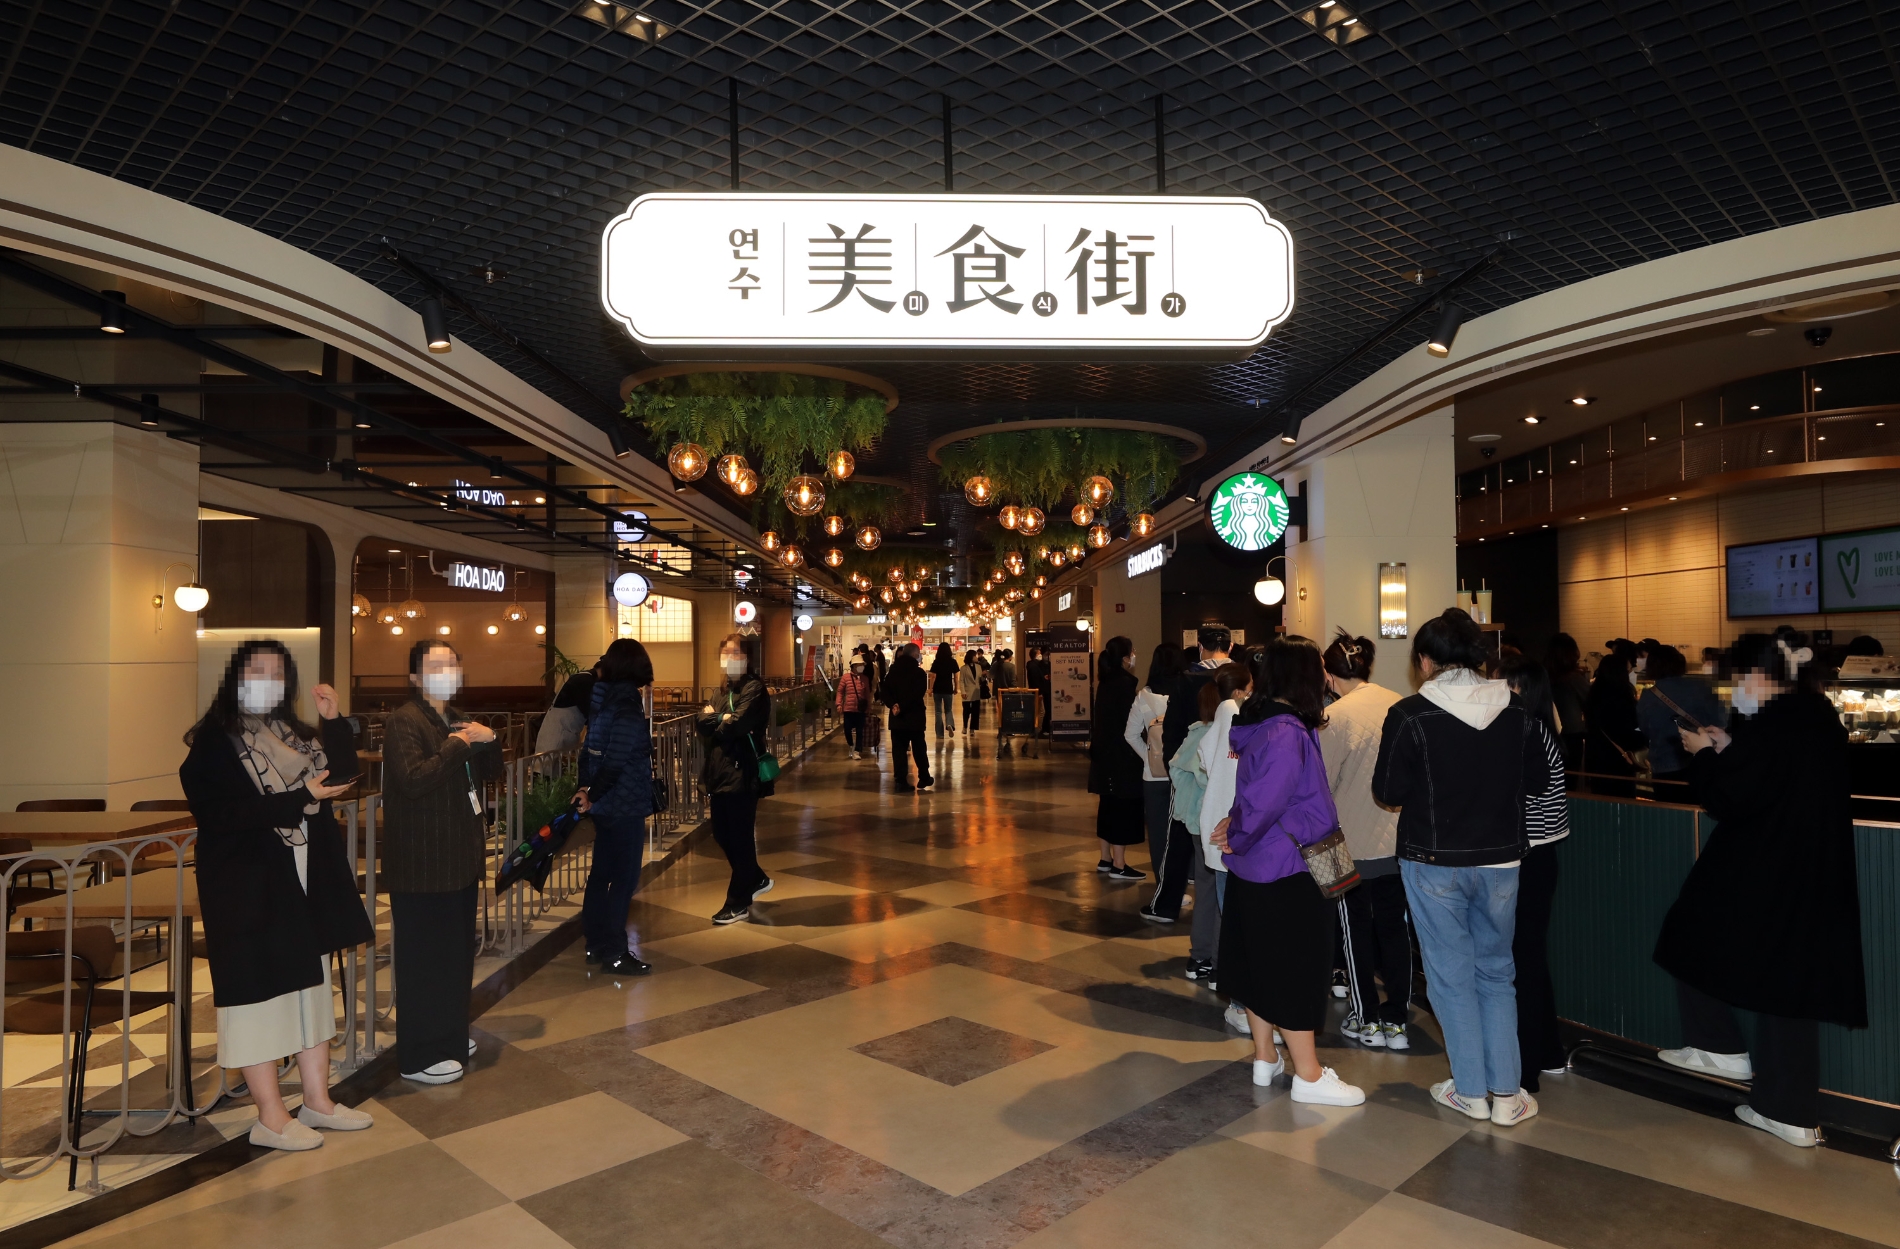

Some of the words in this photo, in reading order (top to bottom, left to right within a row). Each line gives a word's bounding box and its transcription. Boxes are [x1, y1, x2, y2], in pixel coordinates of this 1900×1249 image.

[727, 228, 762, 300] 연수
[908, 294, 925, 312] 미
[1036, 295, 1053, 314] 식
[1165, 295, 1183, 314] 가
[1127, 543, 1163, 578] STARBUCKS
[1874, 551, 1893, 562] LOVE
[455, 564, 480, 589] HOA
[483, 567, 505, 592] DAO
[1874, 566, 1893, 577] LOVE
